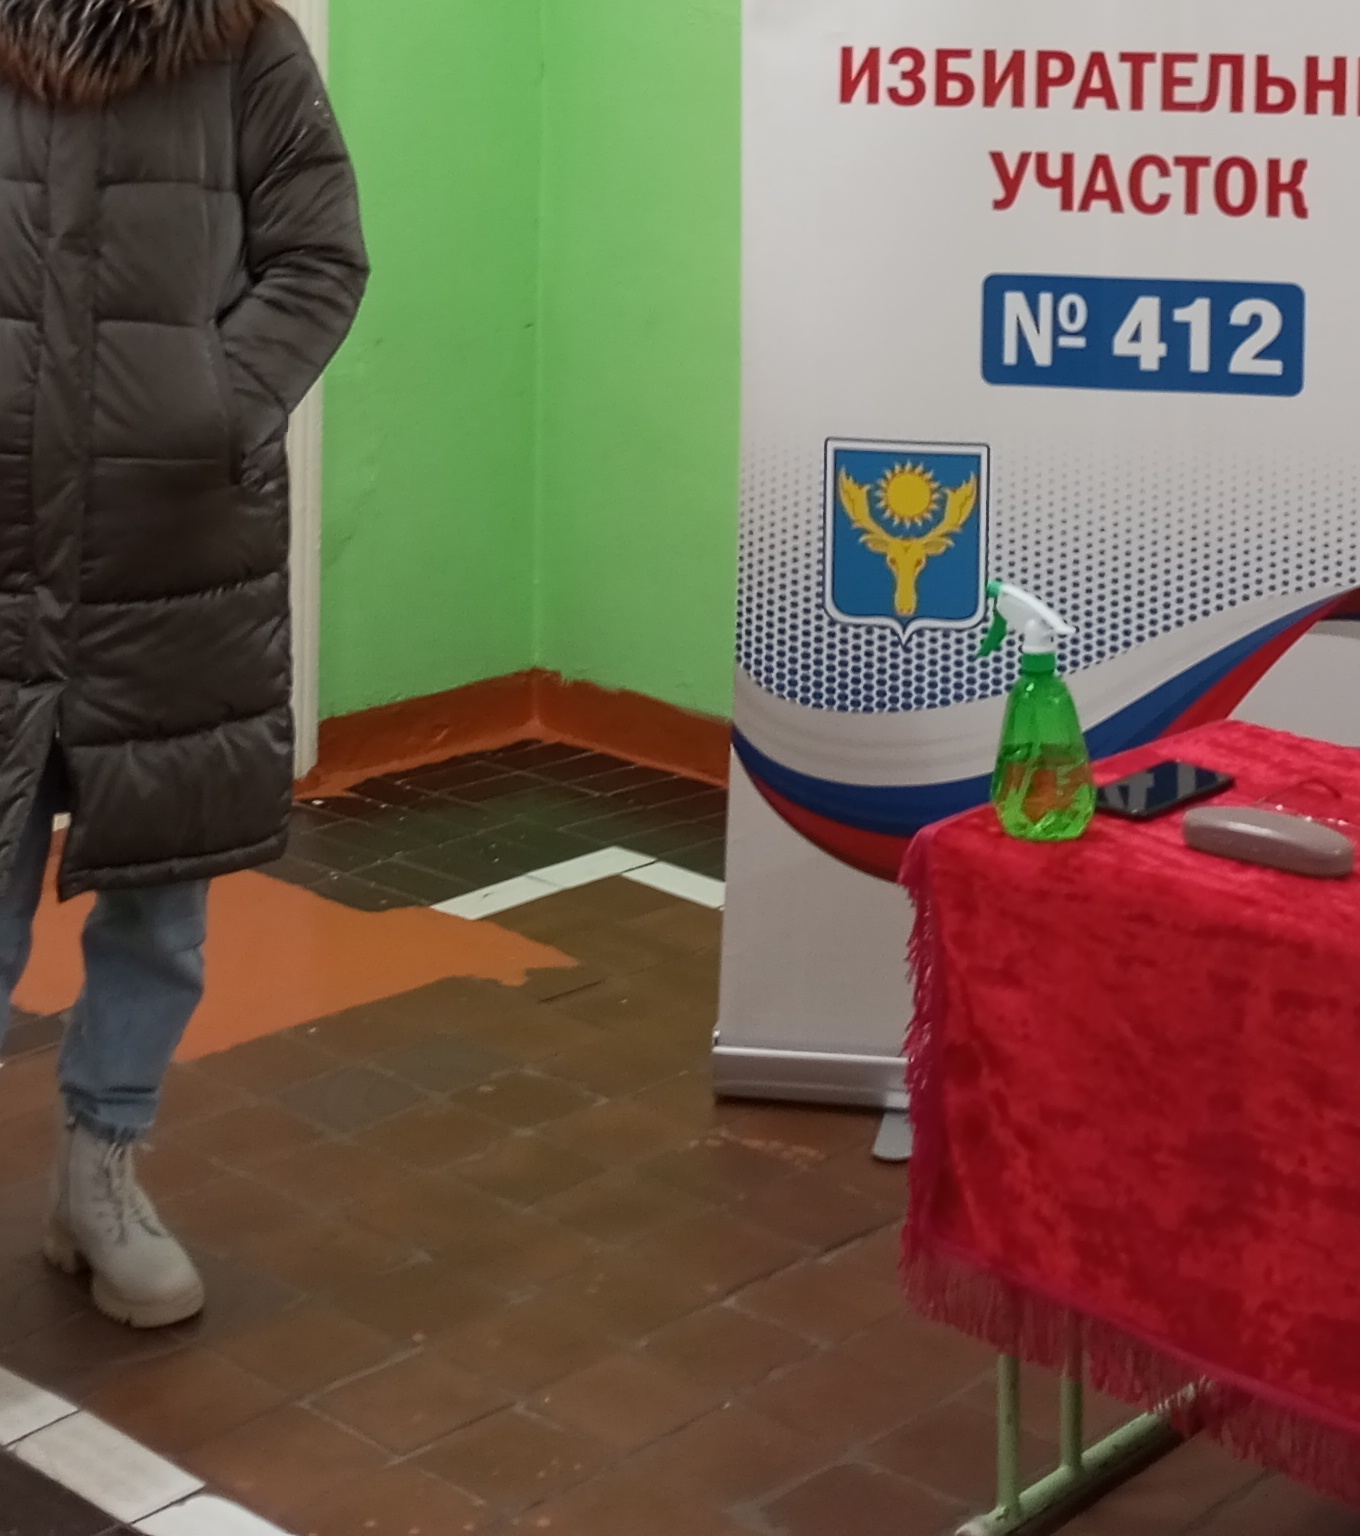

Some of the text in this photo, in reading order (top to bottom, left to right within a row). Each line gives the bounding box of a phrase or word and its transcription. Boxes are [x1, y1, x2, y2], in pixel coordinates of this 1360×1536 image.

[988, 151, 1309, 219] УЧАСТОК
[1002, 290, 1284, 376] № 412
